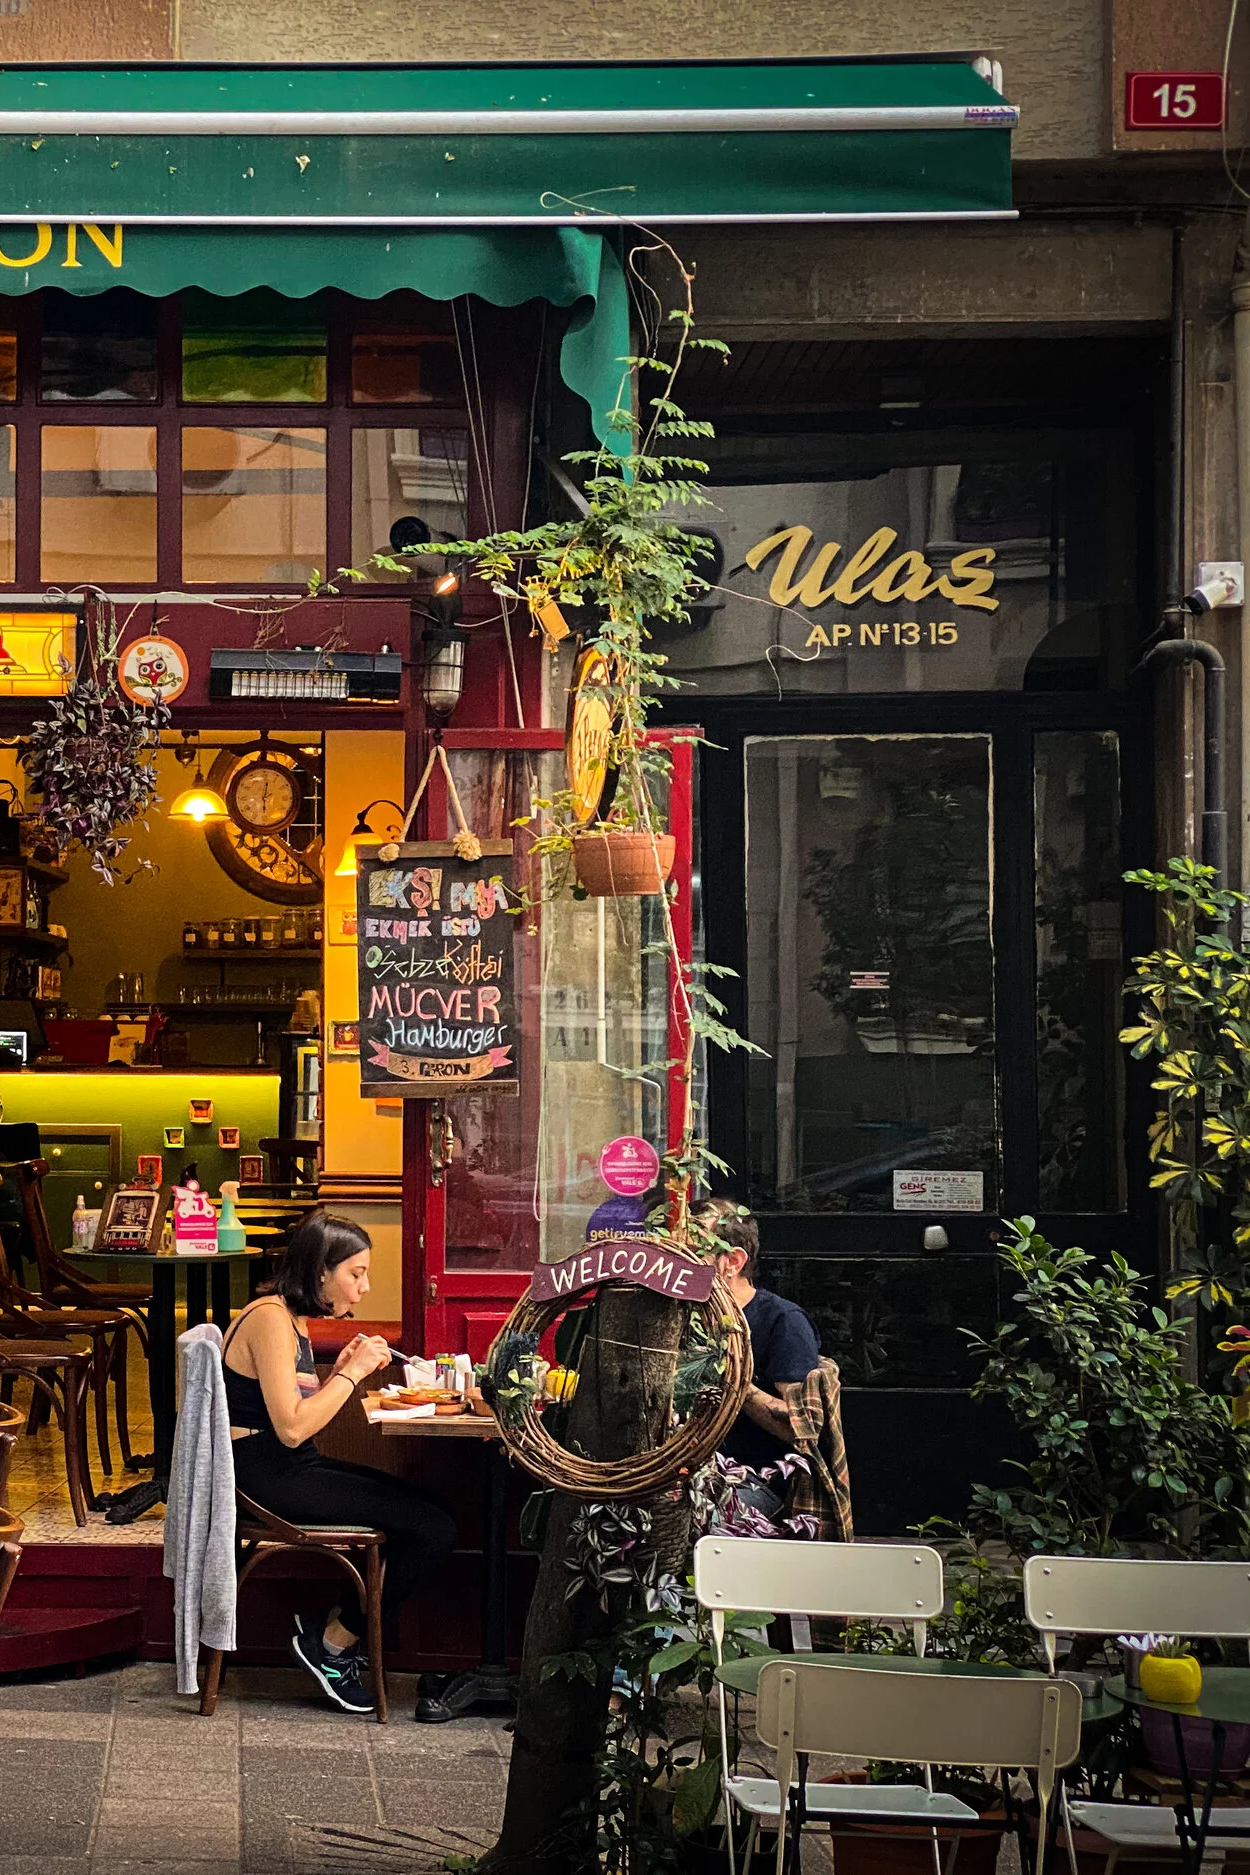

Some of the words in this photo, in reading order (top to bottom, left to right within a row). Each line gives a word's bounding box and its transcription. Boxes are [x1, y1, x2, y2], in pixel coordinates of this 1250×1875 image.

[1153, 83, 1197, 118] 15
[365, 918, 432, 945] EKMEK
[368, 982, 501, 1024] MÜCVER
[384, 1018, 508, 1055] Hamburger
[550, 1250, 693, 1295] WELCOME
